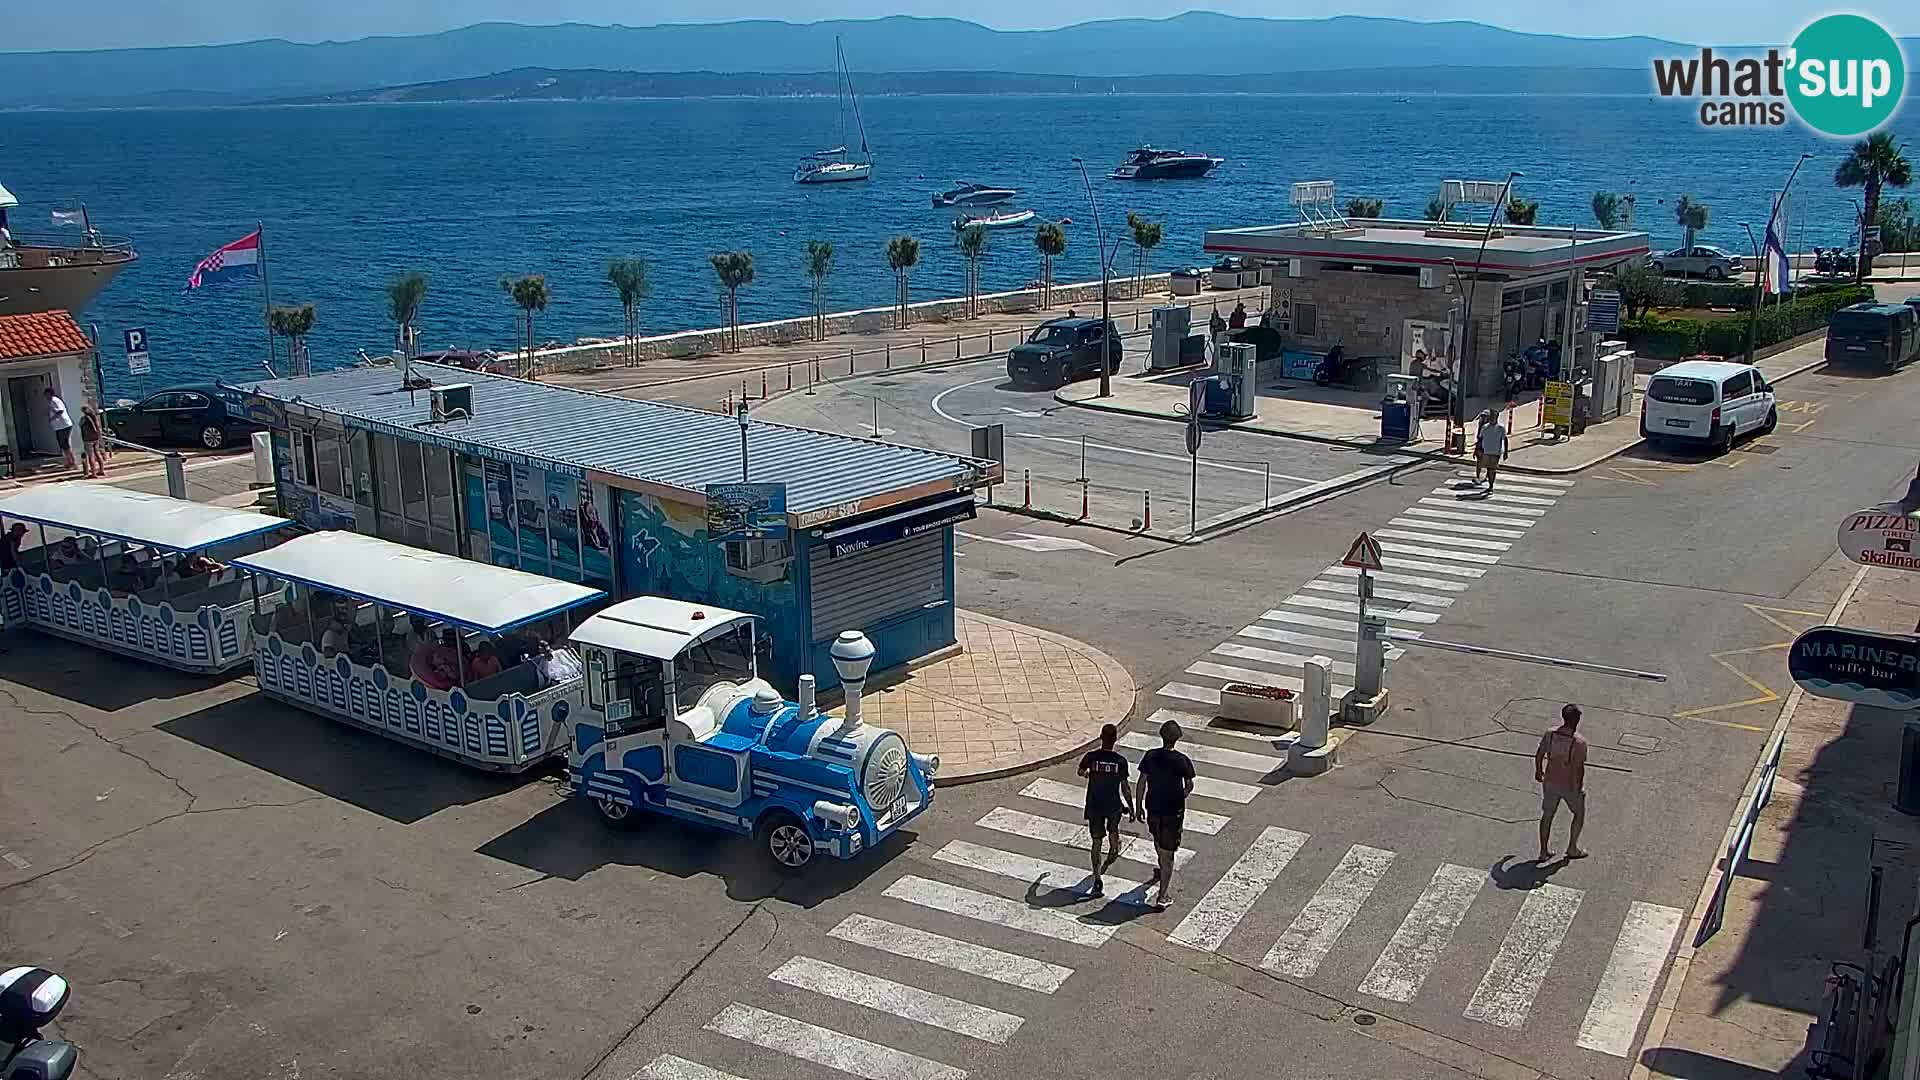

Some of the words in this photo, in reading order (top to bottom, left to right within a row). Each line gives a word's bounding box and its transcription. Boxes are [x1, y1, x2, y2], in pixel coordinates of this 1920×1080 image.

[130, 332, 141, 350] P
[436, 437, 467, 452] POSTAJA
[478, 447, 493, 459] BUS
[494, 449, 526, 465] STATION
[528, 457, 554, 472] TICKET
[555, 463, 582, 478] OFFICE
[912, 525, 926, 534] YOUR
[952, 511, 970, 523] CHOICE
[1848, 515, 1920, 533] PIZZE
[1829, 662, 1866, 674] caffe
[1871, 665, 1897, 680] bar
